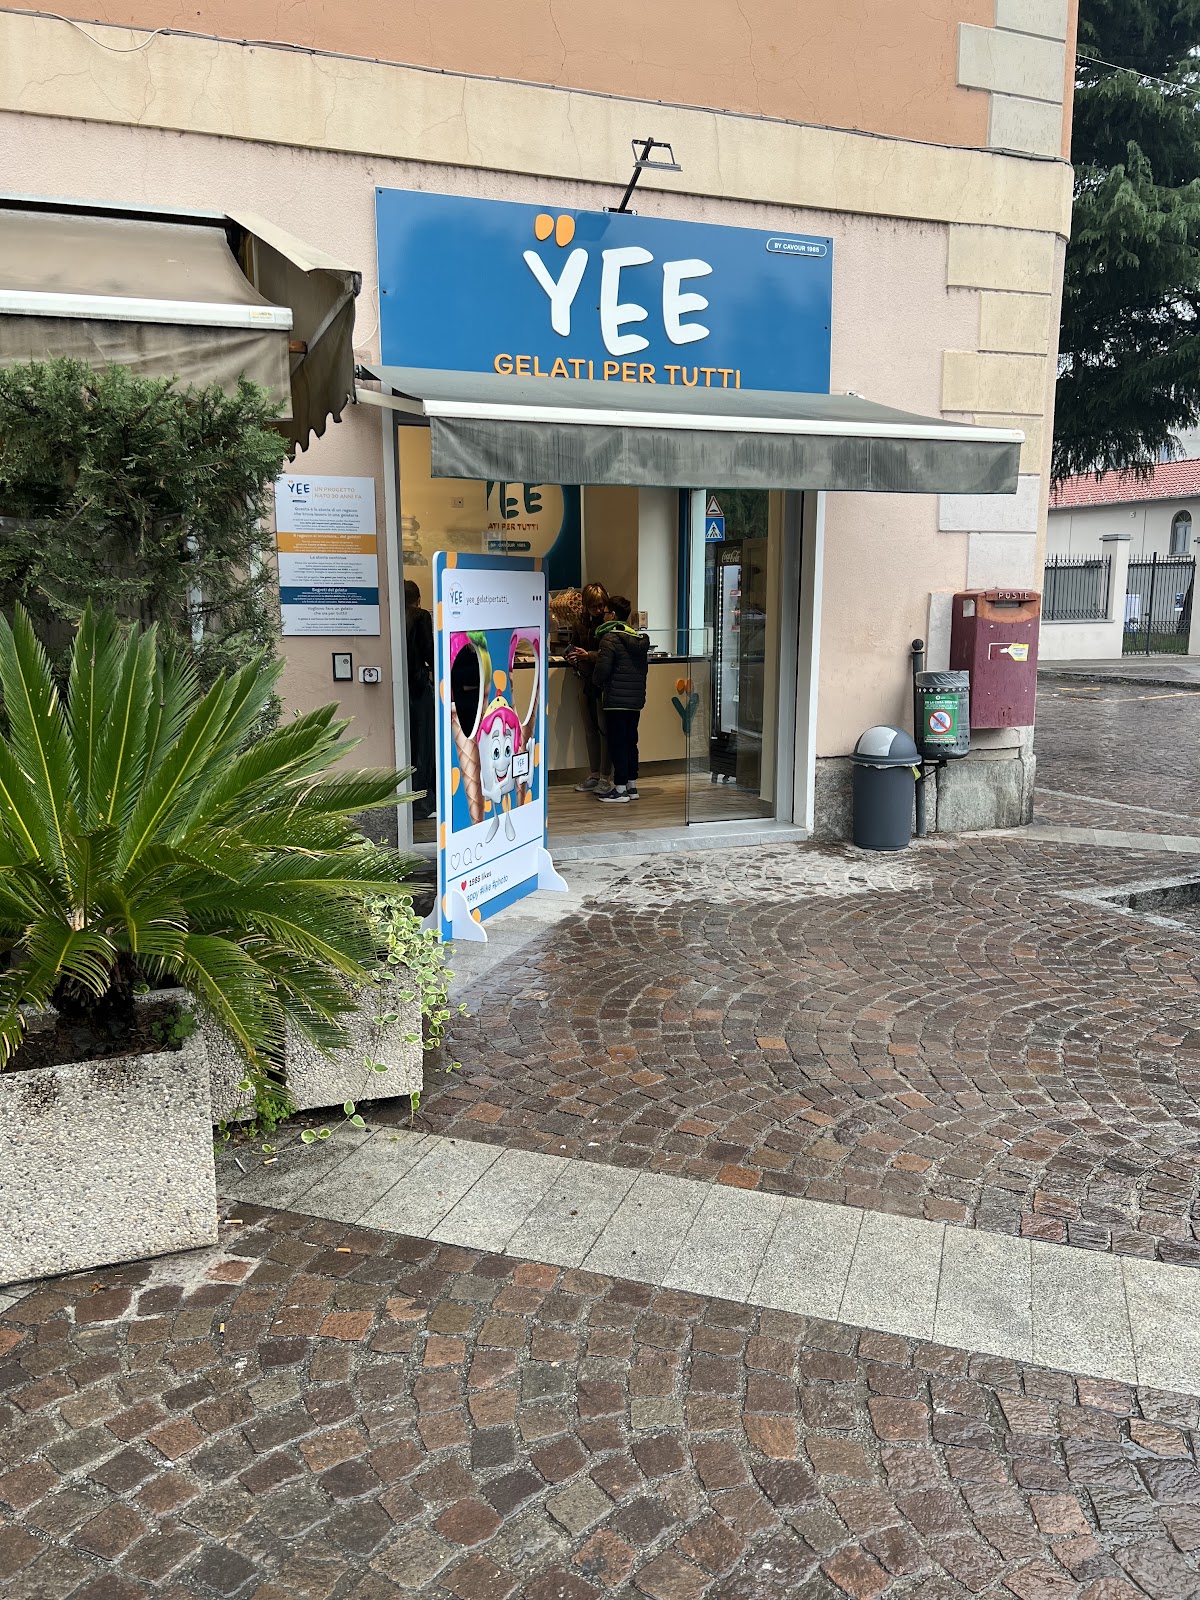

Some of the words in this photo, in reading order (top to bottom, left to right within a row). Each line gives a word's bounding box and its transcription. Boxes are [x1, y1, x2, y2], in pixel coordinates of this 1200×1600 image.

[782, 244, 806, 252] CAVOUR
[522, 246, 714, 357] YEE
[493, 353, 595, 381] GELATI
[603, 361, 657, 384] PER
[664, 365, 742, 389] TUTTI
[287, 482, 310, 494] YEE
[450, 590, 463, 605] YEE
[998, 592, 1029, 600] POSTE
